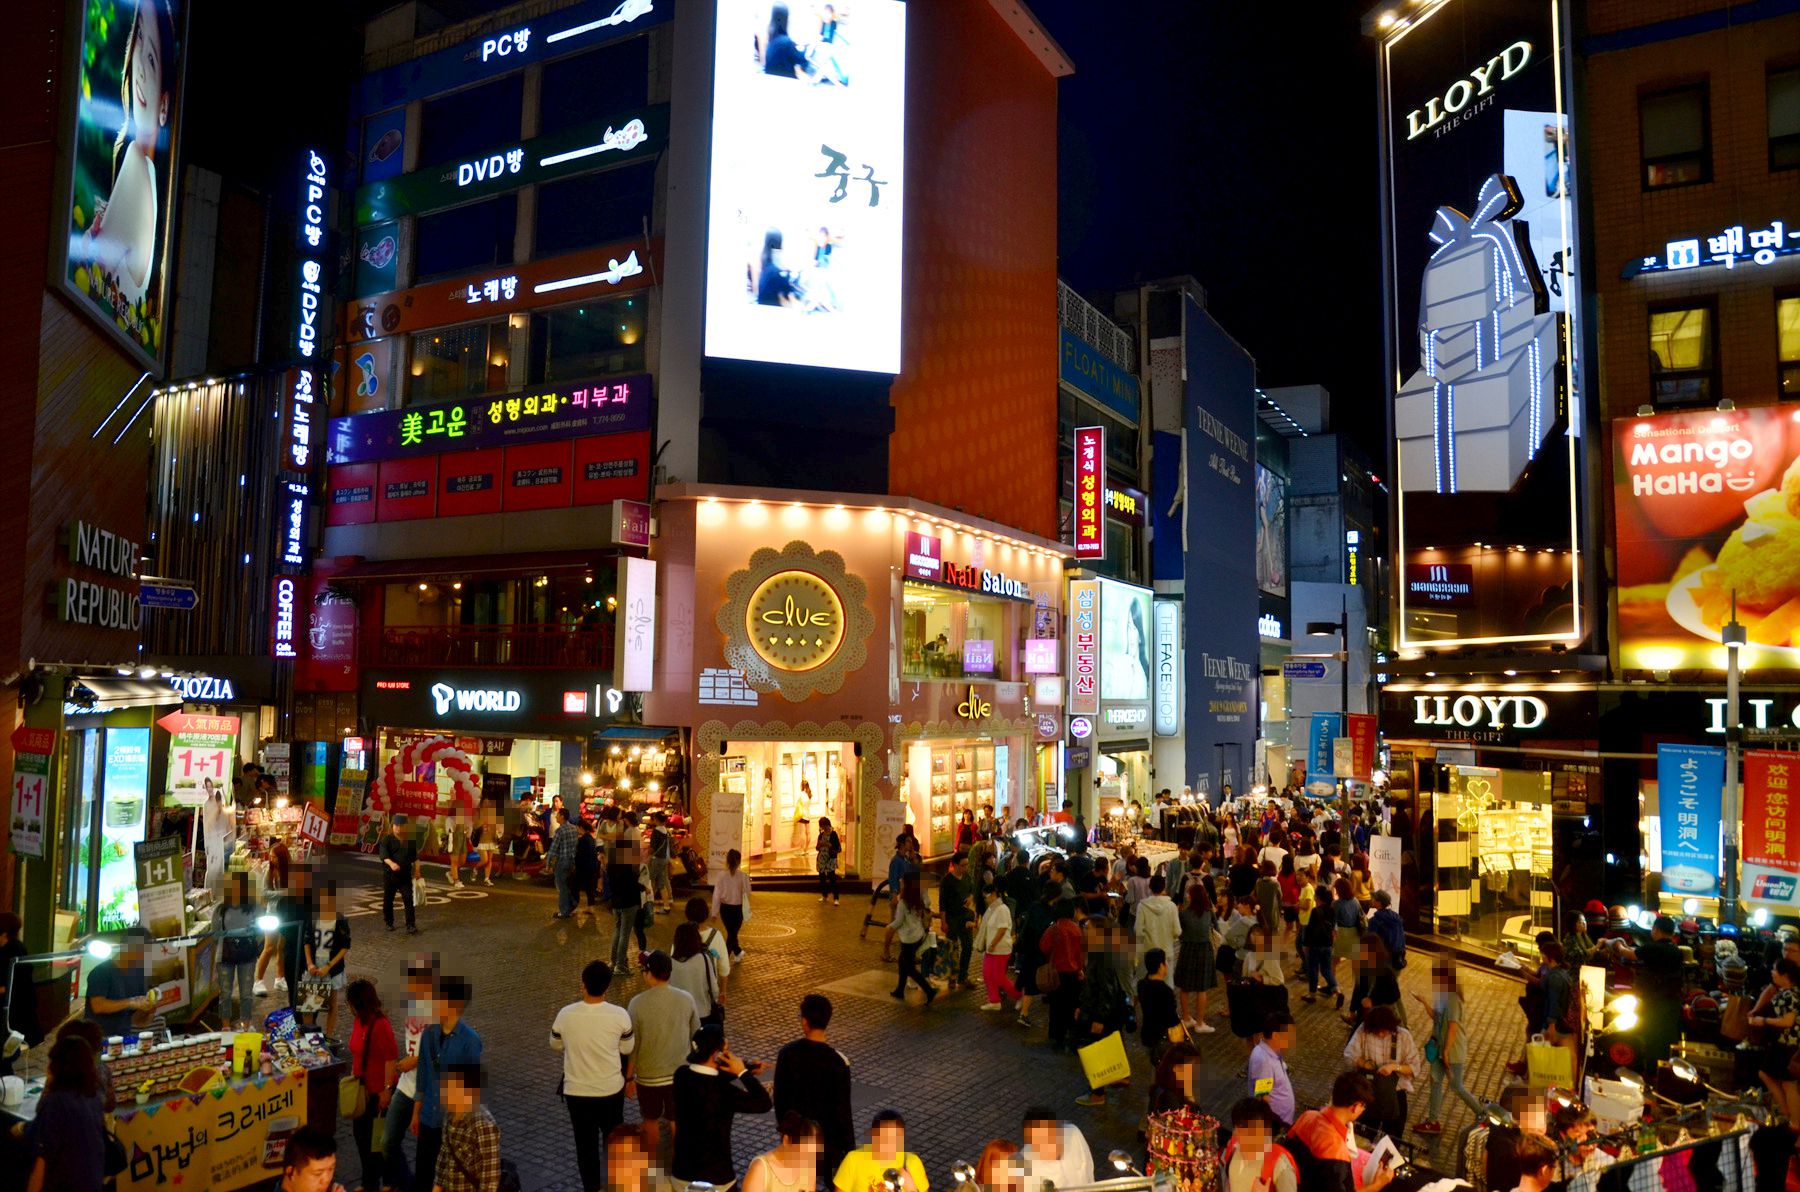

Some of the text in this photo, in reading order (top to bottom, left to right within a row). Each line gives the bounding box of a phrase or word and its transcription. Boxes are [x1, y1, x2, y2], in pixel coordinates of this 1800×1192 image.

[482, 27, 531, 62] PC방
[1405, 40, 1533, 141] LLOYD
[1434, 92, 1496, 139] THE GIFT
[457, 148, 524, 187] DVD방
[815, 143, 889, 208] 중구
[1708, 221, 1800, 270] 백명
[466, 276, 519, 304] 노래방
[1630, 438, 1754, 469] Mango
[1081, 475, 1097, 540] 성형외과
[76, 520, 139, 580] NATURE
[944, 561, 980, 590] Nail
[982, 568, 1022, 598] Salon
[65, 577, 140, 632] REPUBLIC
[276, 579, 294, 641] COFFEE
[762, 594, 831, 627] clue
[1076, 589, 1095, 695] 삼성 부동산
[1202, 652, 1252, 682] TEENIE WEENIE
[170, 676, 234, 700] ZIOZIA
[456, 690, 521, 713] WORLD
[958, 684, 991, 720] clue
[182, 717, 233, 731] 人氣商品
[1413, 694, 1549, 729] LLOYD
[1445, 729, 1504, 742] THE GIFT
[178, 749, 225, 778] 1+1
[15, 774, 42, 817] 1+1
[1677, 758, 1699, 853] ようこそ明洞へ
[308, 815, 323, 839] 1+1
[143, 856, 176, 887] 1+1
[1755, 879, 1794, 890] UnionPay
